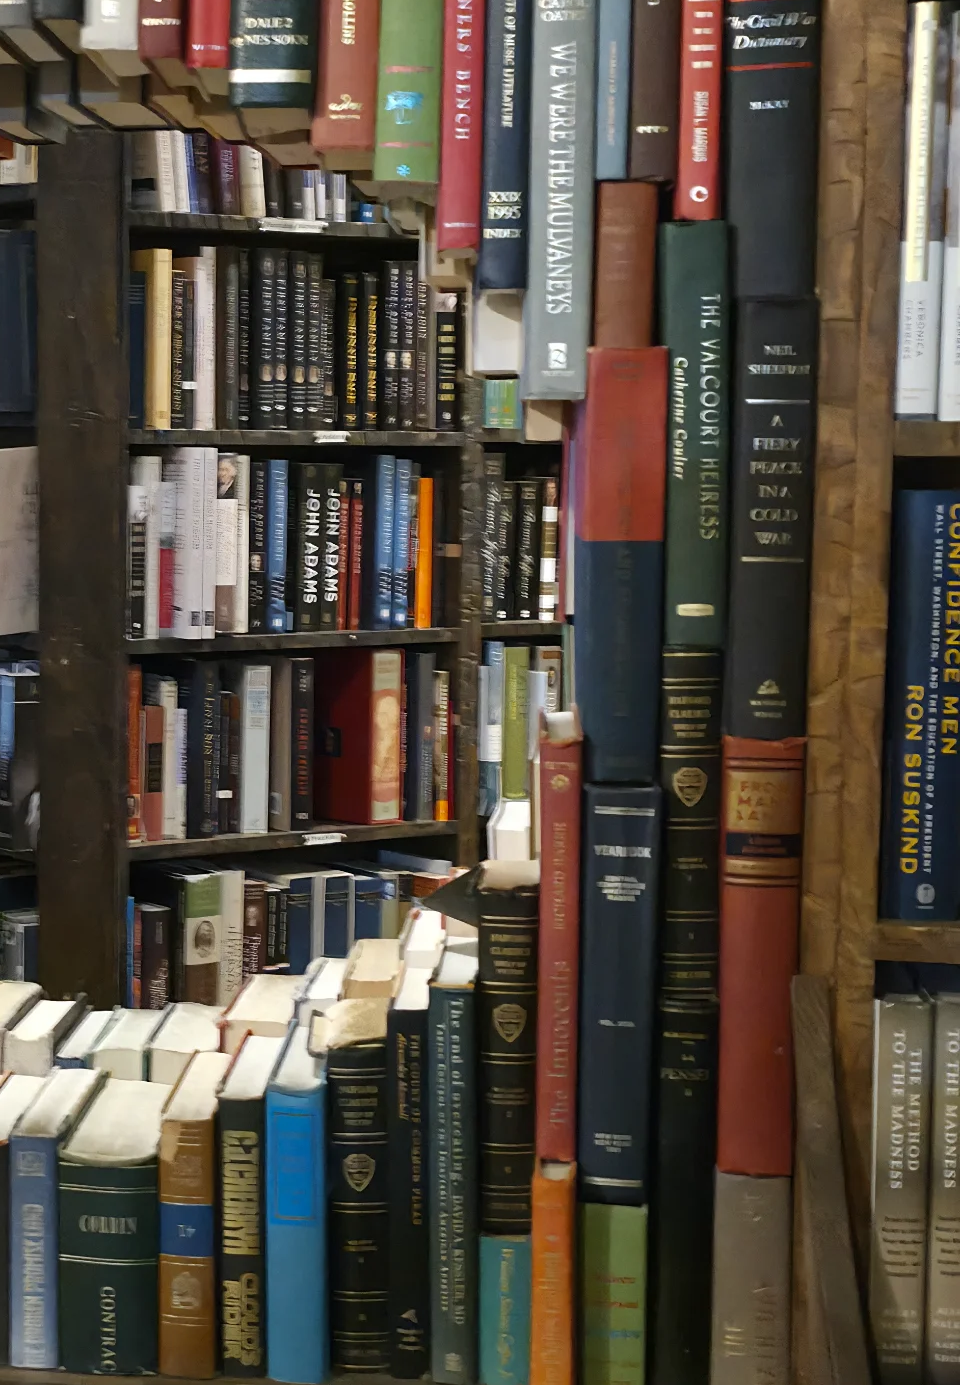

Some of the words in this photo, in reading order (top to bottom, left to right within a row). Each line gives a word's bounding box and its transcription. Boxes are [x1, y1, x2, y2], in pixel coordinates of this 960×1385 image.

[549, 41, 576, 75] WE
[454, 70, 471, 141] BENCH
[549, 81, 576, 146] WERE
[549, 150, 574, 186] THE
[545, 188, 574, 314] MULVANEYS
[700, 293, 721, 330] THE
[674, 356, 689, 423] Catherine
[699, 336, 721, 450] VALCOURT
[672, 429, 687, 480] Coulter
[303, 486, 320, 535] JOHN
[324, 486, 342, 535] JOHN
[699, 456, 720, 541] HEIRESS
[303, 541, 320, 603] ADAMS
[323, 541, 341, 602] ADAMS
[907, 685, 925, 741] RON
[902, 754, 923, 875] SUSKIND
[893, 1030, 906, 1056] TO
[909, 1049, 922, 1086] THE
[893, 1061, 905, 1096] THE
[890, 1106, 905, 1190] MADNESS
[907, 1094, 921, 1171] METHOD
